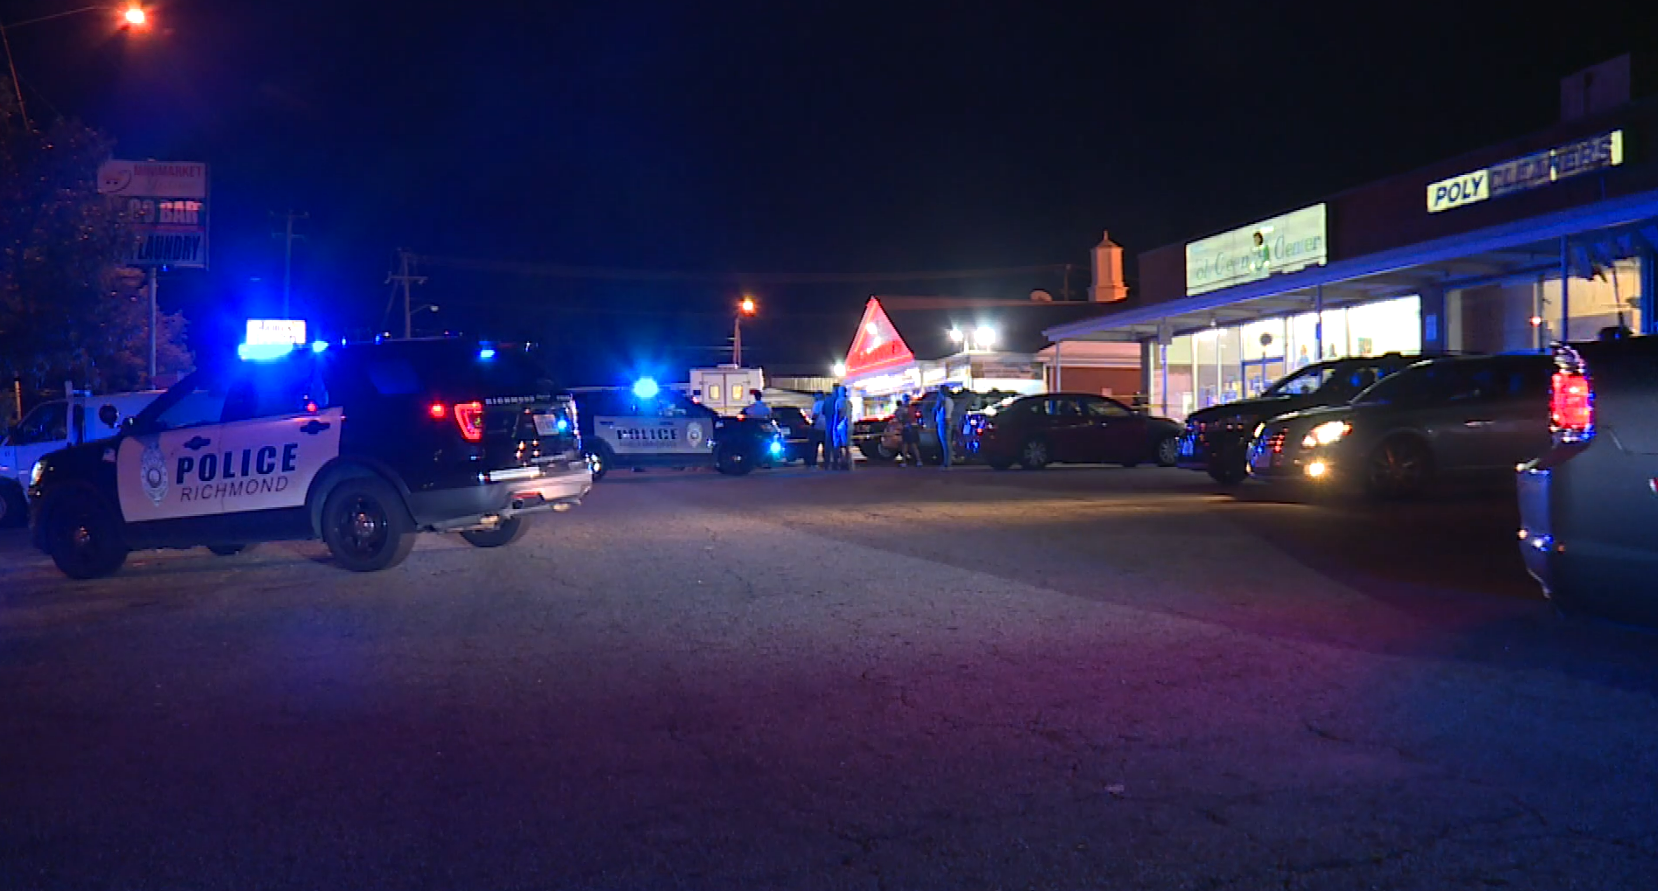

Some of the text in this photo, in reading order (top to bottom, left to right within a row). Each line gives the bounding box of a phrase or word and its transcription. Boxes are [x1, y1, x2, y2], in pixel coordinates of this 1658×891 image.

[1434, 174, 1484, 208] POLY
[137, 235, 201, 260] LAUNDRY
[616, 427, 678, 440] POLICE
[176, 442, 298, 485] POLICE
[180, 475, 289, 502] RICHMOND
